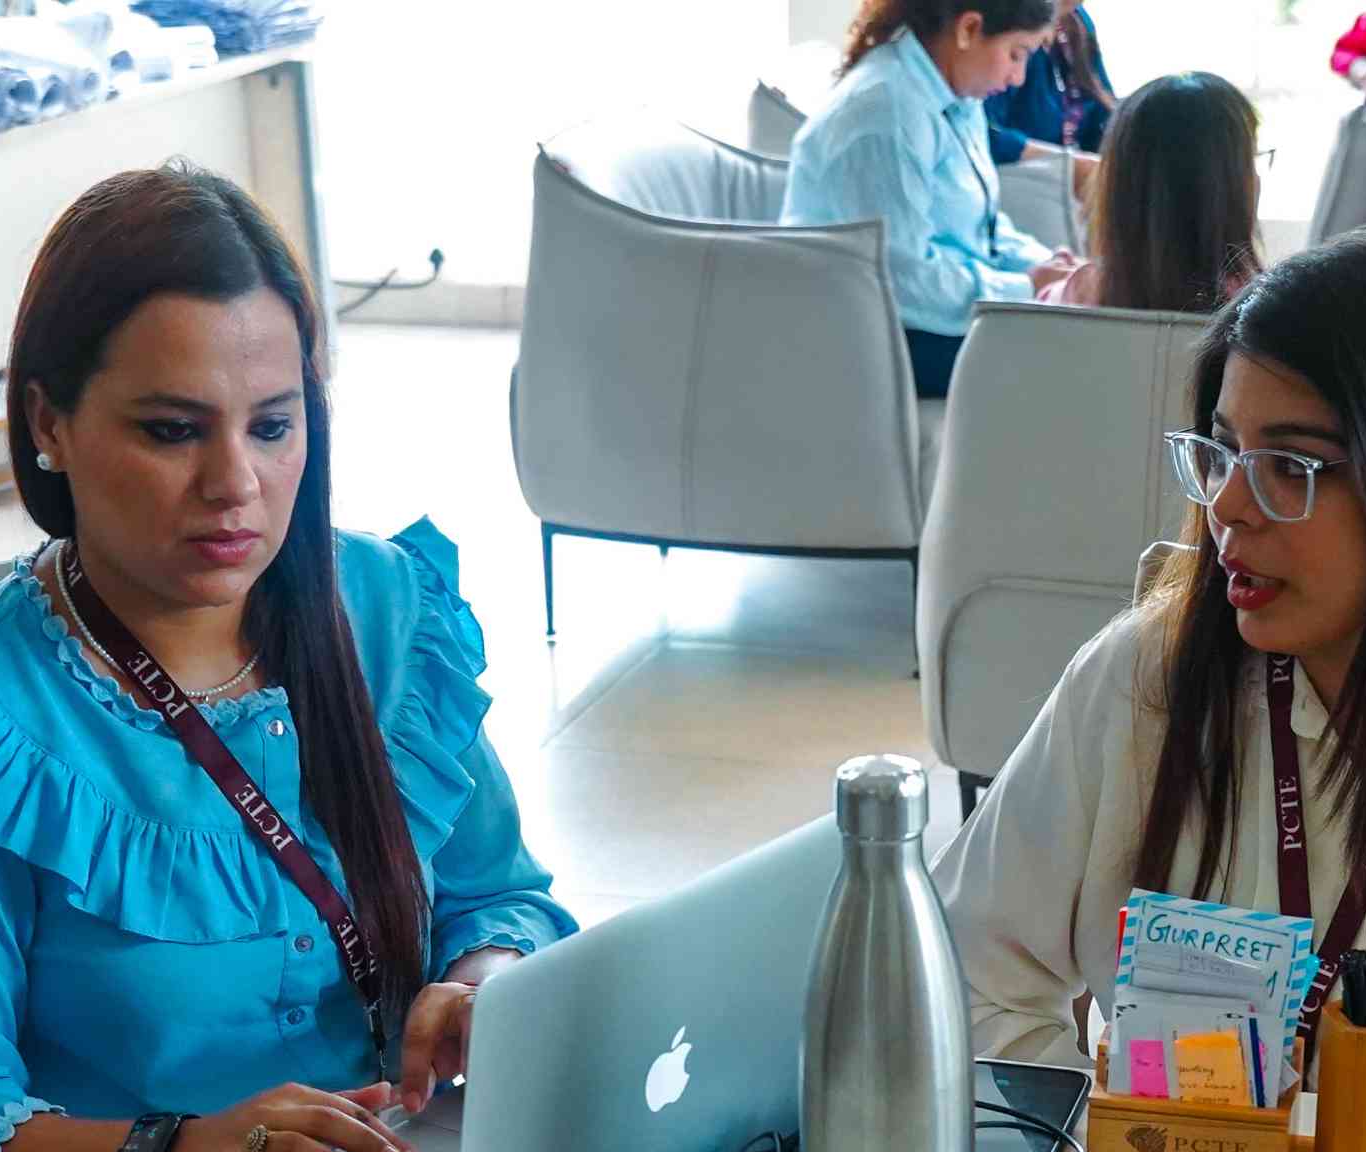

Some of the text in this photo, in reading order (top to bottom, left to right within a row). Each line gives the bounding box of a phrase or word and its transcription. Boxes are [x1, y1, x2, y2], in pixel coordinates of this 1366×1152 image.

[127, 651, 189, 720] PCTE
[1271, 655, 1291, 685] PC
[235, 783, 294, 851] PCTE
[1279, 776, 1303, 851] PCTE
[336, 915, 367, 983] PCTE
